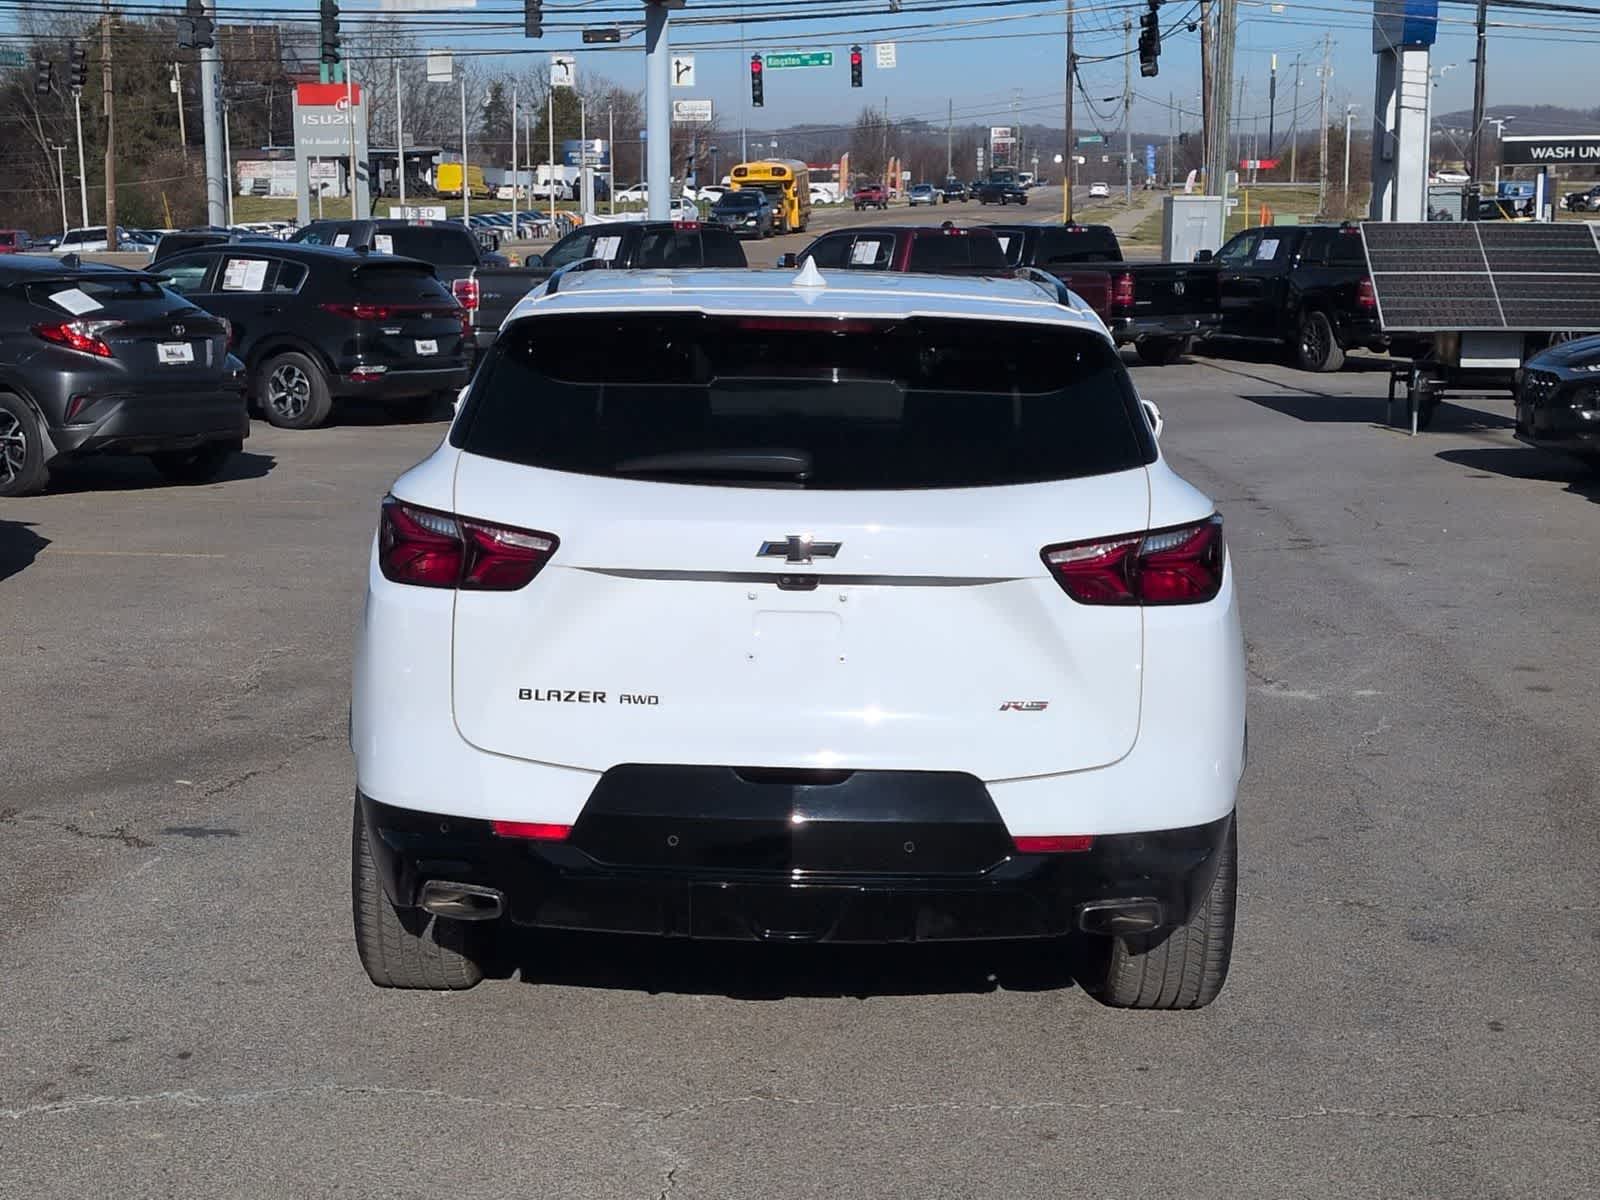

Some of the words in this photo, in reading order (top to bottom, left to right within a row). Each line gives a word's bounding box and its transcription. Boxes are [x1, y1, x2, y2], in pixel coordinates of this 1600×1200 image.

[768, 56, 801, 67] Kingston
[302, 114, 357, 125] ISUZU
[1530, 146, 1575, 159] WASH
[402, 208, 434, 218] USED
[518, 687, 607, 704] BLAZER
[619, 693, 660, 706] AWD
[999, 701, 1049, 712] RS
